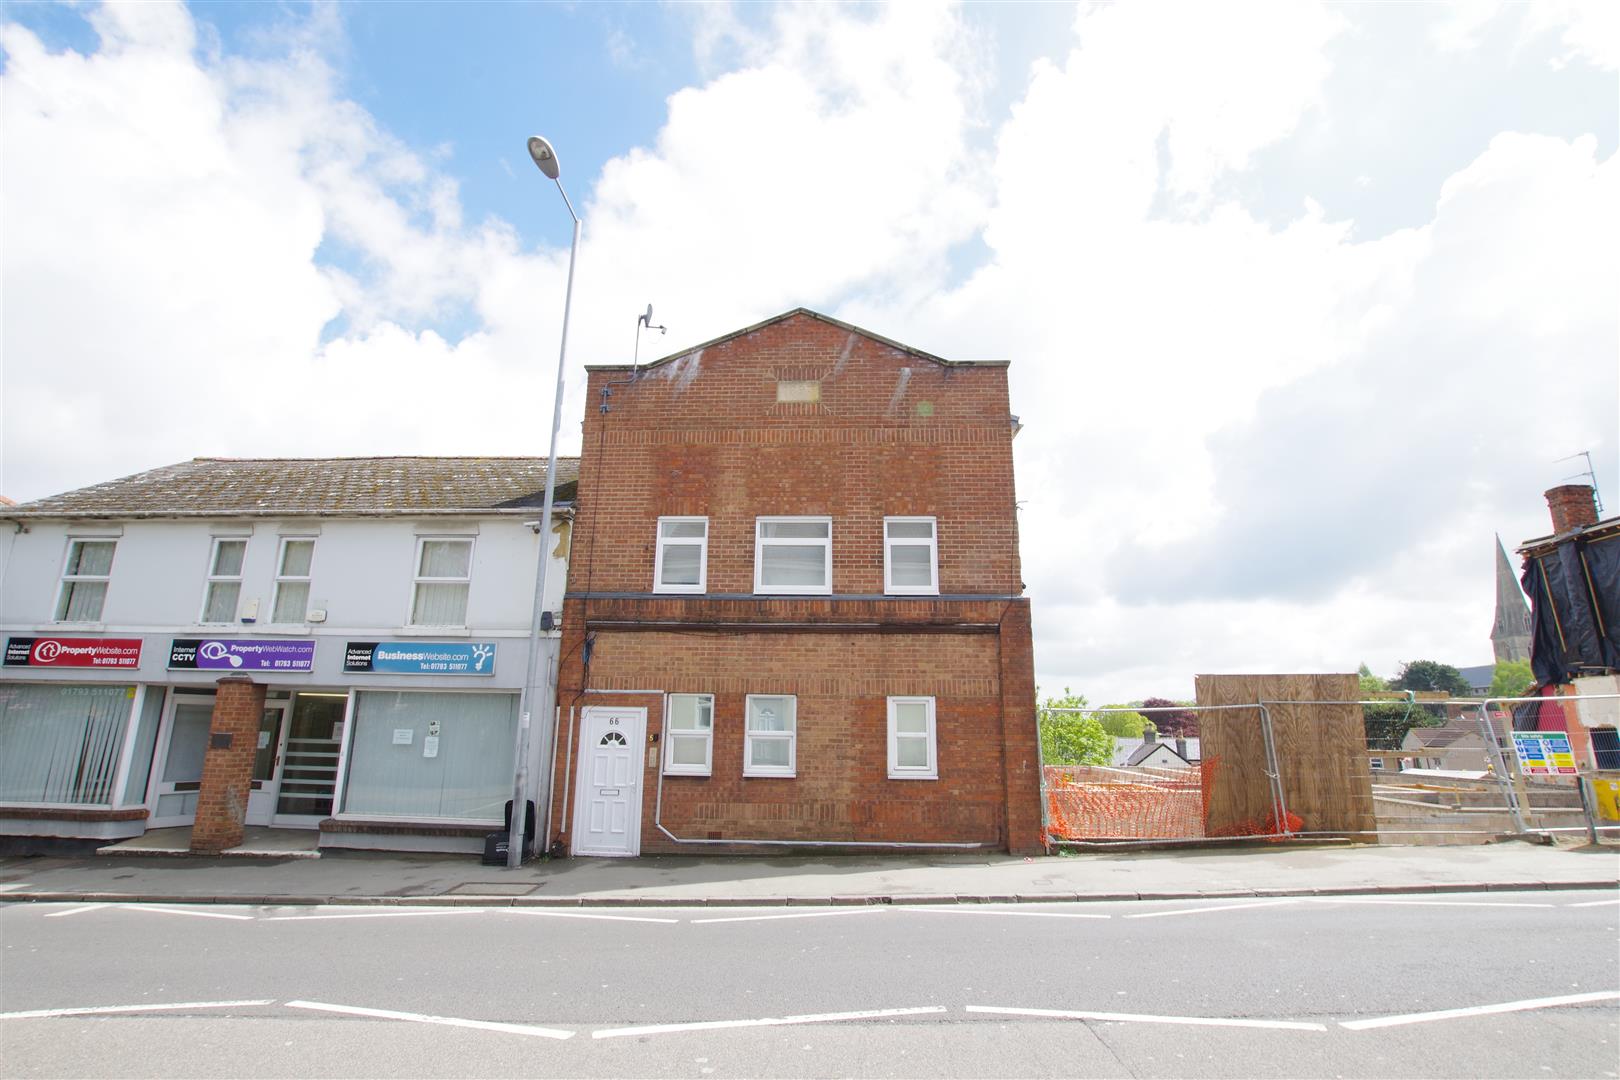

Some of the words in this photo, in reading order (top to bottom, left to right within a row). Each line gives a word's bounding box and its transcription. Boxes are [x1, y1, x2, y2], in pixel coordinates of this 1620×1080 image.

[61, 646, 138, 656] PropertyWebsite.com
[230, 645, 312, 654] PropertyWebWatch.com
[171, 653, 196, 662] CCTV
[377, 651, 469, 661] BusinessWebsite.com
[292, 660, 311, 668] 511077
[91, 688, 126, 696] 511077
[609, 717, 619, 725] 66
